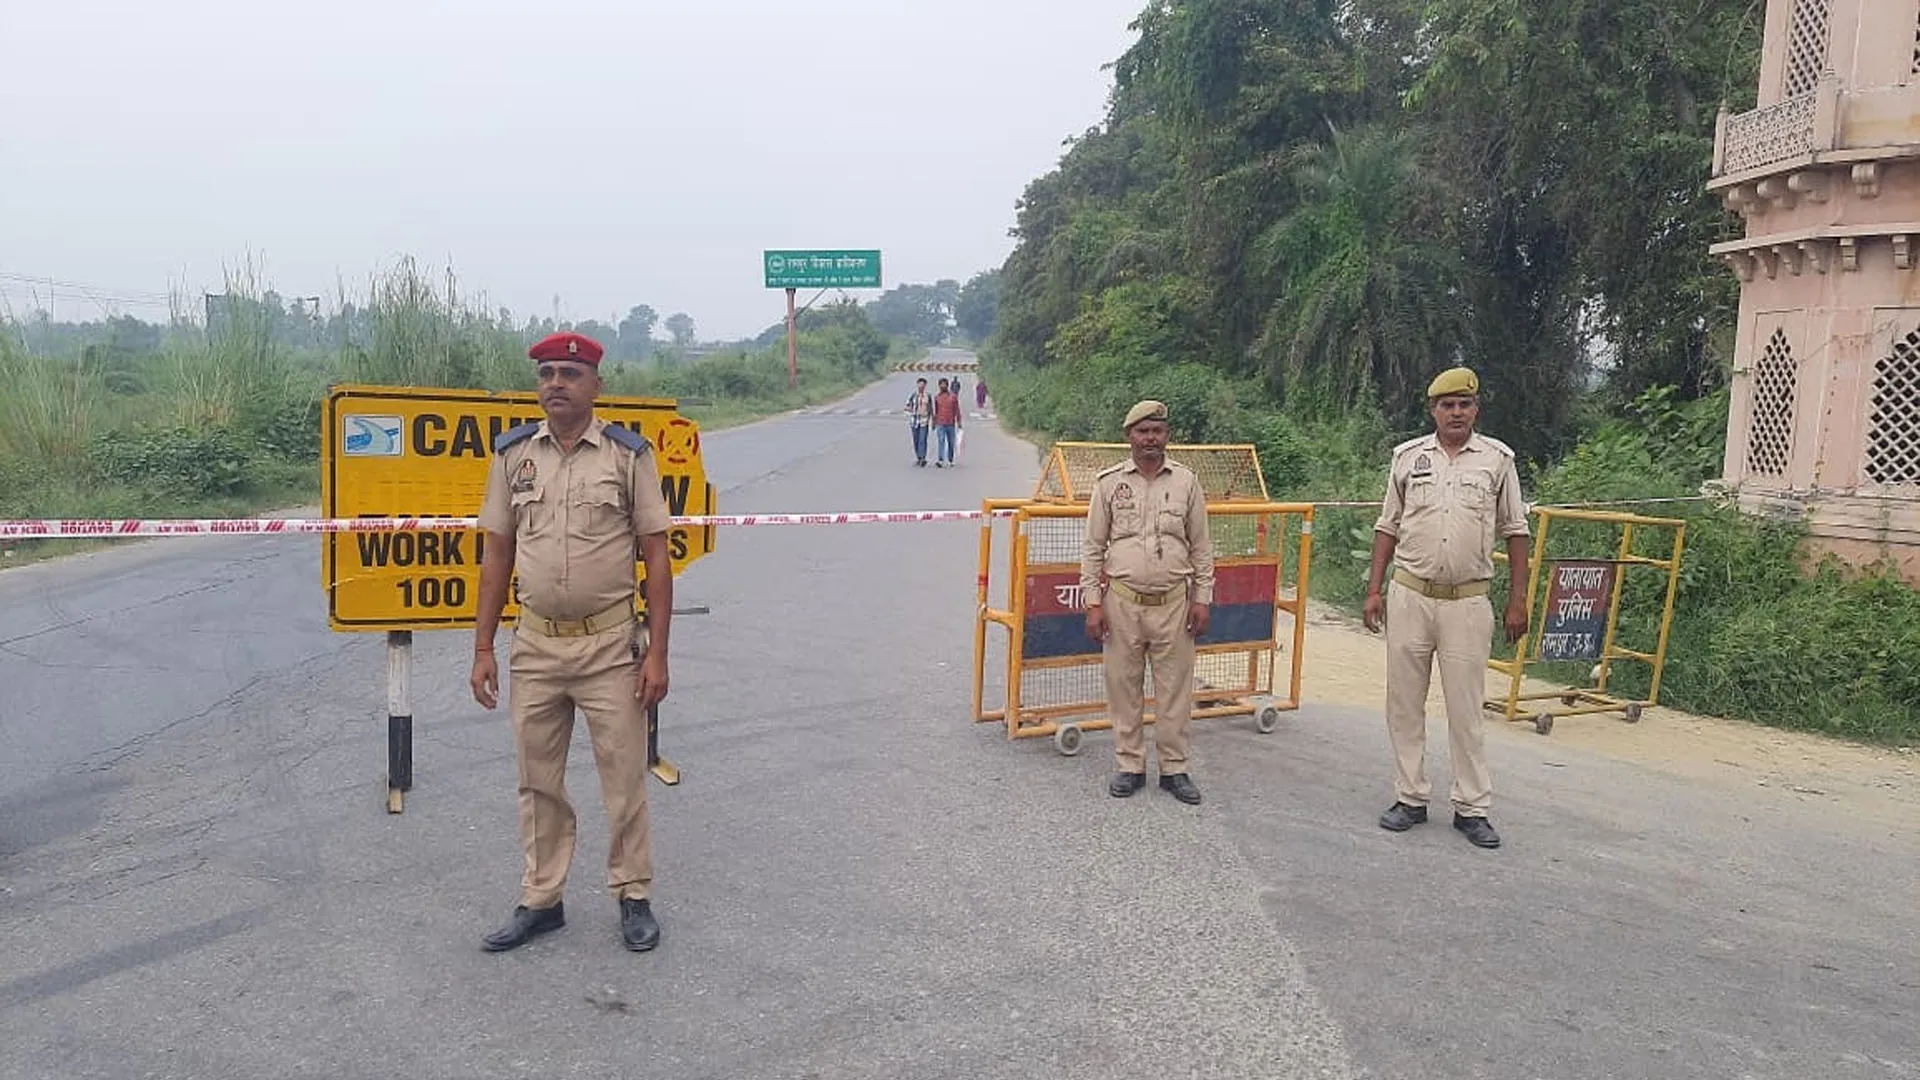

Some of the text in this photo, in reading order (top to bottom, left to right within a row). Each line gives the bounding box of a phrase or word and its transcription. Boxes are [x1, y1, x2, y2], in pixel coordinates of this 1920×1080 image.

[412, 413, 641, 457] CAUN
[356, 531, 464, 567] WORK
[397, 576, 466, 608] 100
[1558, 567, 1606, 590] यातायात
[1555, 592, 1597, 627] पुलिस
